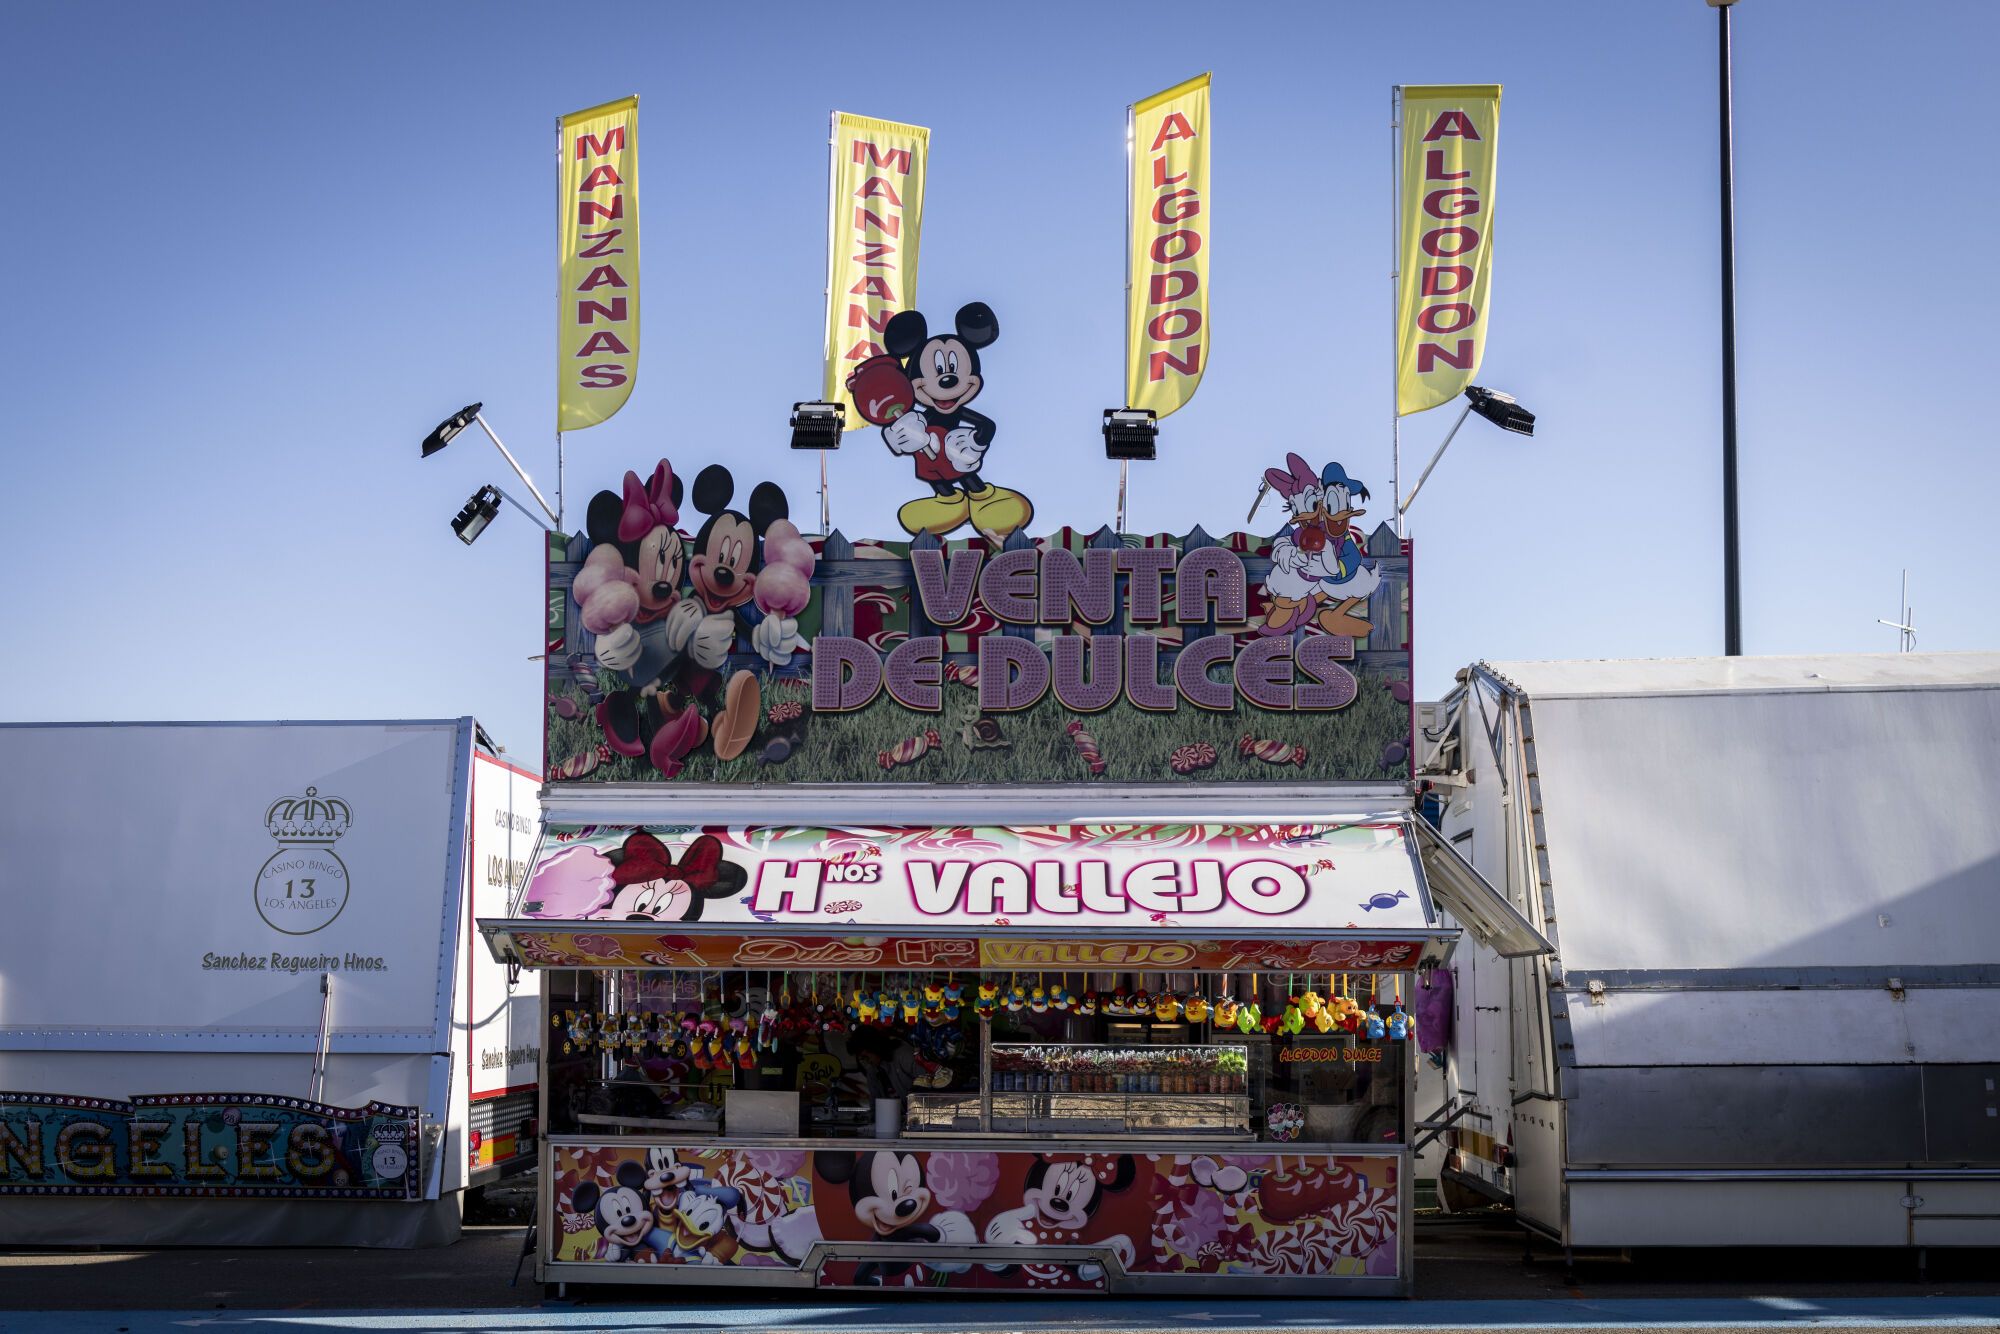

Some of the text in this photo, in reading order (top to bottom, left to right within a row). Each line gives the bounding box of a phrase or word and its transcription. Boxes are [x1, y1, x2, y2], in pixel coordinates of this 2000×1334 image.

[576, 125, 631, 388] MANZANAS
[844, 140, 912, 379] MANZANA
[1147, 111, 1202, 382] ALGODON
[1416, 111, 1482, 374] ALGODON
[909, 547, 1247, 625] VENTA
[811, 634, 1358, 712] DE DULCES
[263, 859, 344, 879] CASINO BINGO
[285, 878, 316, 899] 13
[906, 860, 1306, 914] VALLEJO
[264, 897, 337, 910] LOS ANGELES
[201, 952, 267, 972] Sanchez
[270, 952, 340, 975] Regueiro
[741, 942, 876, 962] Dulces
[992, 943, 1189, 963] VALLEJO
[1279, 1047, 1384, 1063] ALGODON DULCE
